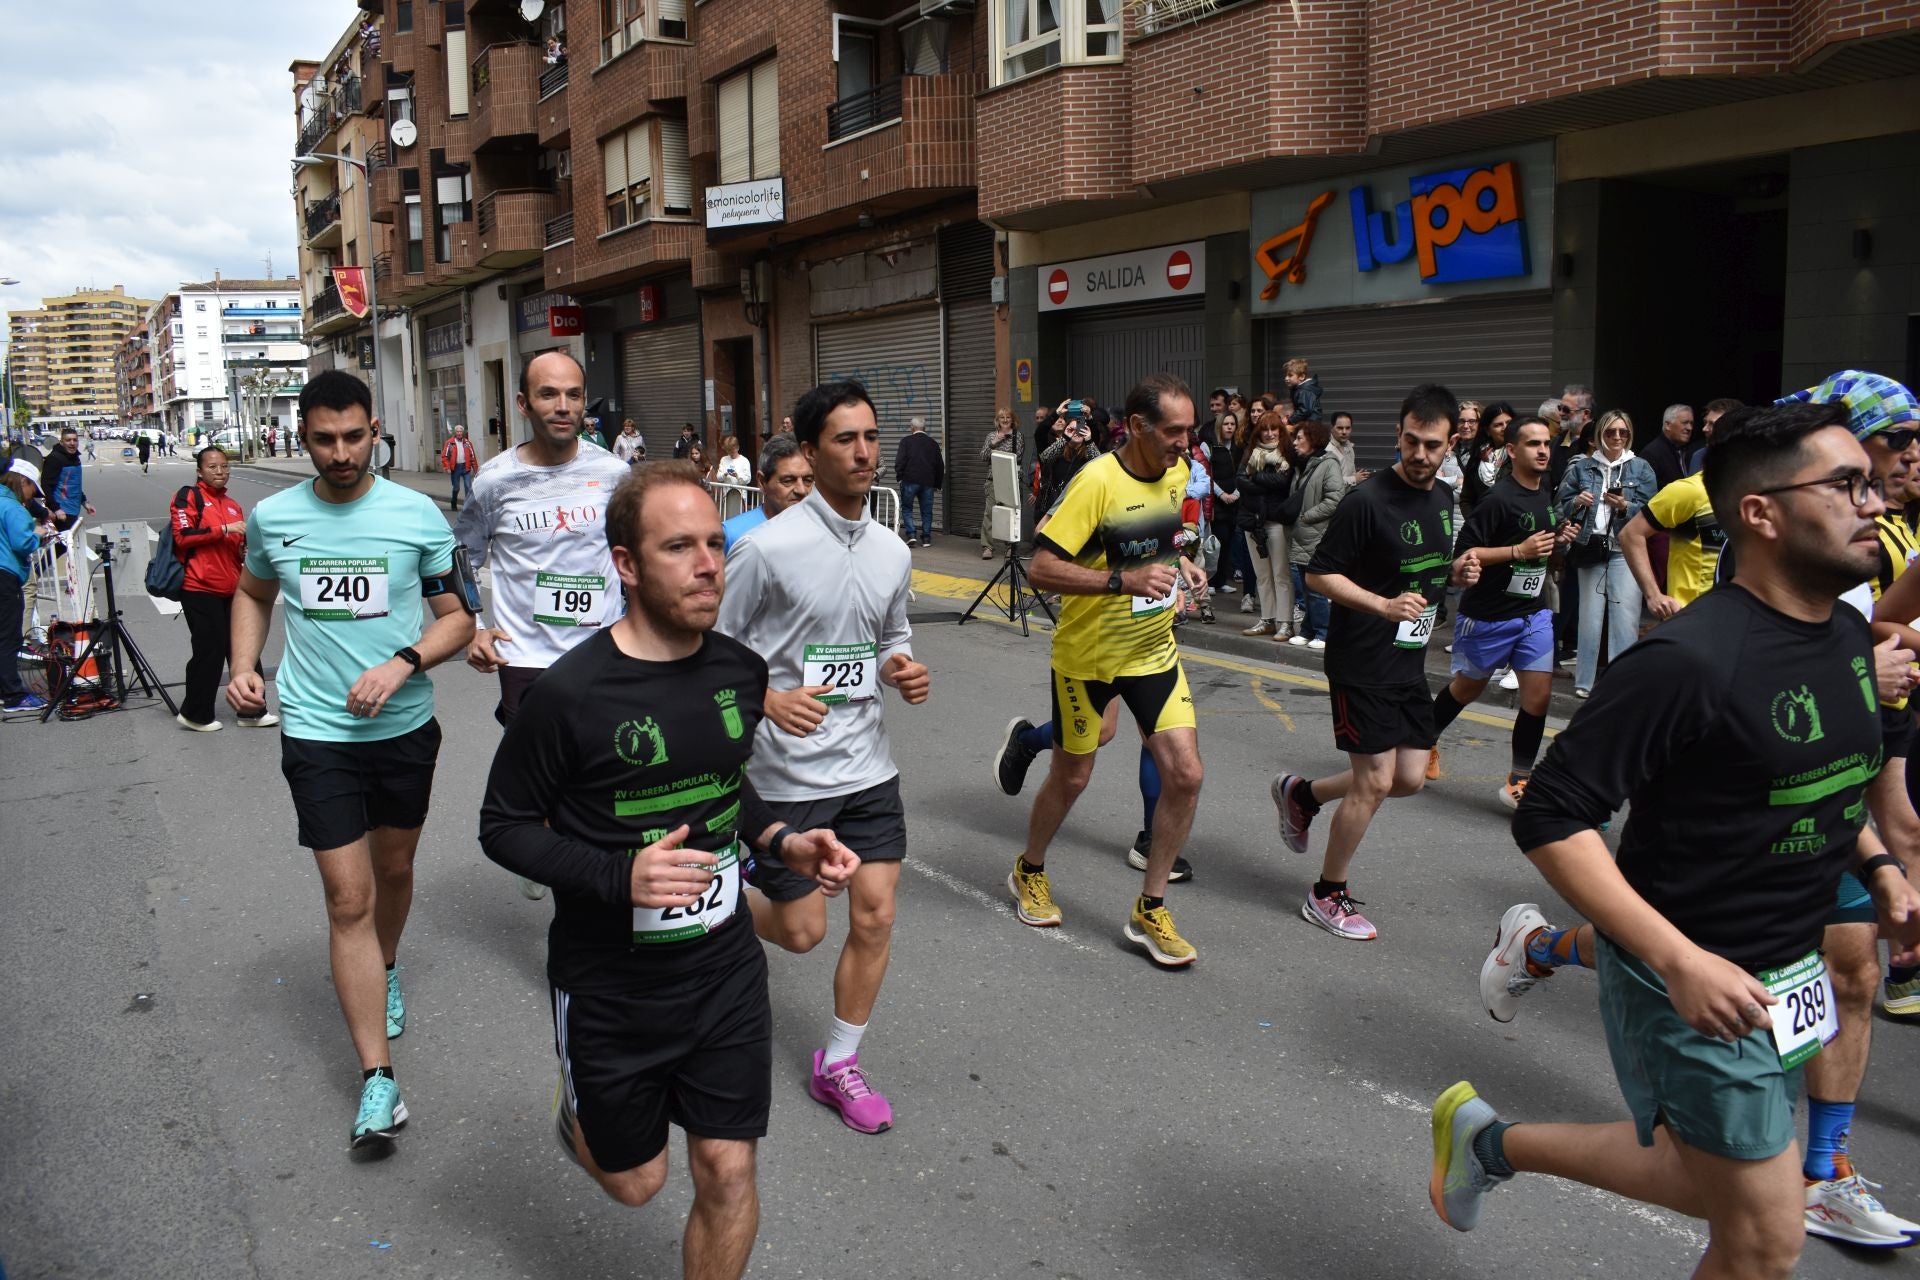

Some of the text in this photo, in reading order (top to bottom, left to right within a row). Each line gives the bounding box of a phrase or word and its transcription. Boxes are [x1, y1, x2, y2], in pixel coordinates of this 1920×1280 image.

[1350, 161, 1521, 279] lupa
[1086, 265, 1146, 292] SALIDA
[316, 576, 370, 602] 240
[1522, 577, 1540, 591] 69
[551, 590, 592, 613] 199
[821, 661, 864, 688] 223
[1772, 753, 1860, 786] XV CARRERA POPULAR
[614, 773, 709, 799] XV CARRERA POPULAR
[1786, 979, 1826, 1036] 289
